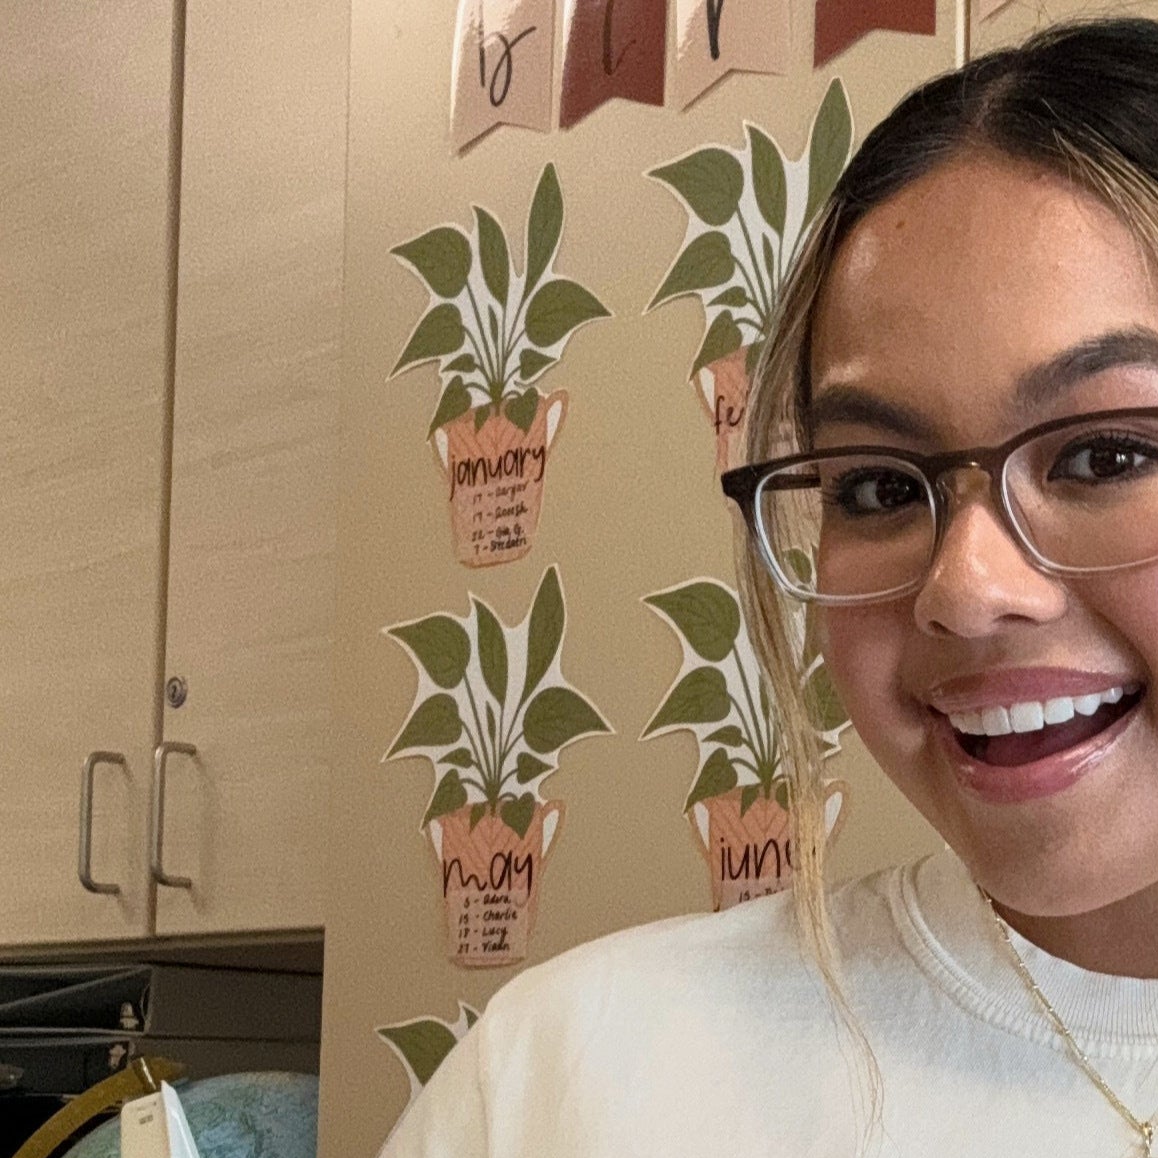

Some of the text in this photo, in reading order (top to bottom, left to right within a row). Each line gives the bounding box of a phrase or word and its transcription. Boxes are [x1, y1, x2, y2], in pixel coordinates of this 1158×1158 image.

[450, 445, 546, 502] january
[443, 850, 533, 905] may
[483, 907, 517, 922] Charlie
[482, 926, 508, 944] Lucy
